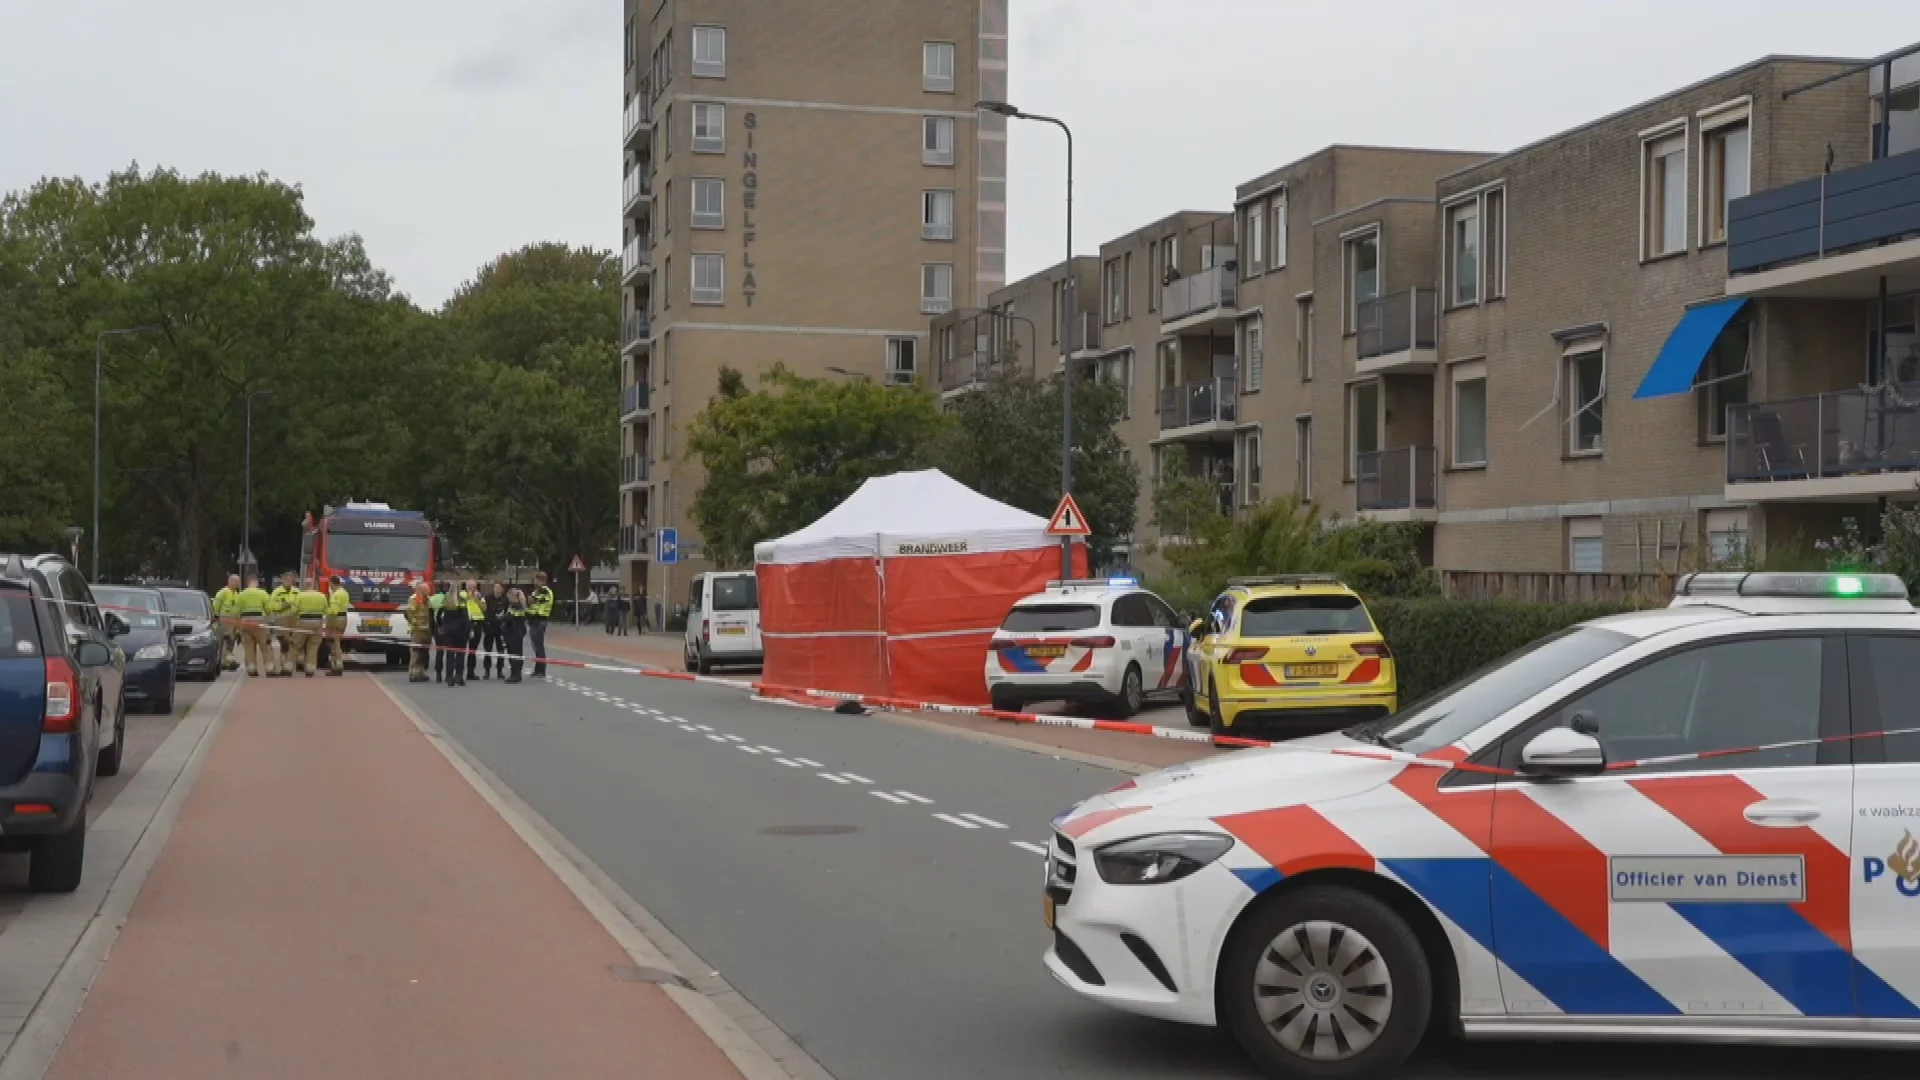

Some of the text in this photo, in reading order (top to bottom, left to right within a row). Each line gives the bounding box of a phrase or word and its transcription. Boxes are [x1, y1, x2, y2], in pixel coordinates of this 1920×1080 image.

[743, 112, 757, 308] SINGELFLAT
[899, 542, 968, 554] BRANDWEER
[350, 569, 405, 578] BRANDWEER
[1616, 871, 1798, 887] Officier van Dienst
